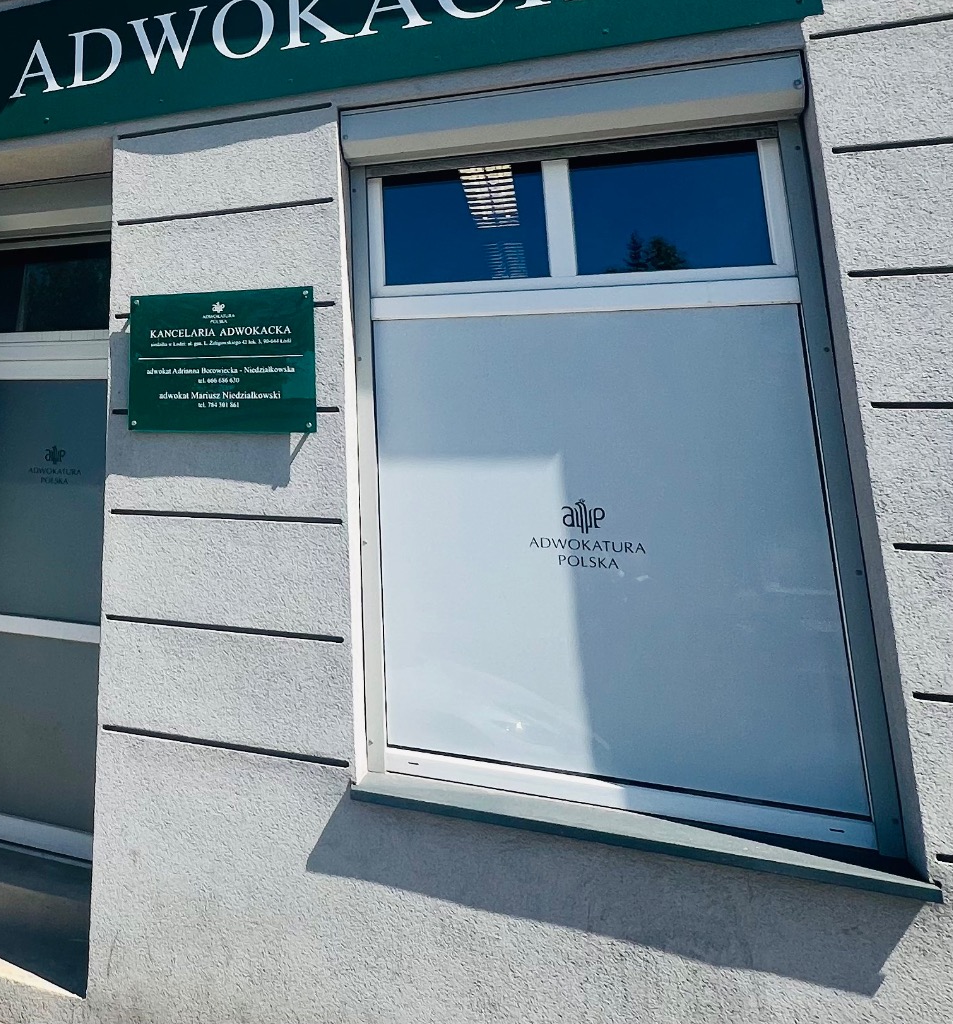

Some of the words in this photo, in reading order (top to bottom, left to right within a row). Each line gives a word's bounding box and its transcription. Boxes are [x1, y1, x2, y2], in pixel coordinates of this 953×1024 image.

[150, 327, 216, 339] KANCELARIA
[219, 325, 292, 337] ADWOKACKA
[146, 367, 172, 375] adwokat
[172, 367, 200, 375] Adrianna
[158, 391, 189, 400] adwokat
[190, 391, 220, 400] Mariusz
[28, 467, 82, 476] ADWOKATURA
[40, 477, 68, 485] POLSKA
[529, 536, 646, 554] ADWOKATURA
[558, 554, 619, 569] POLSKA
